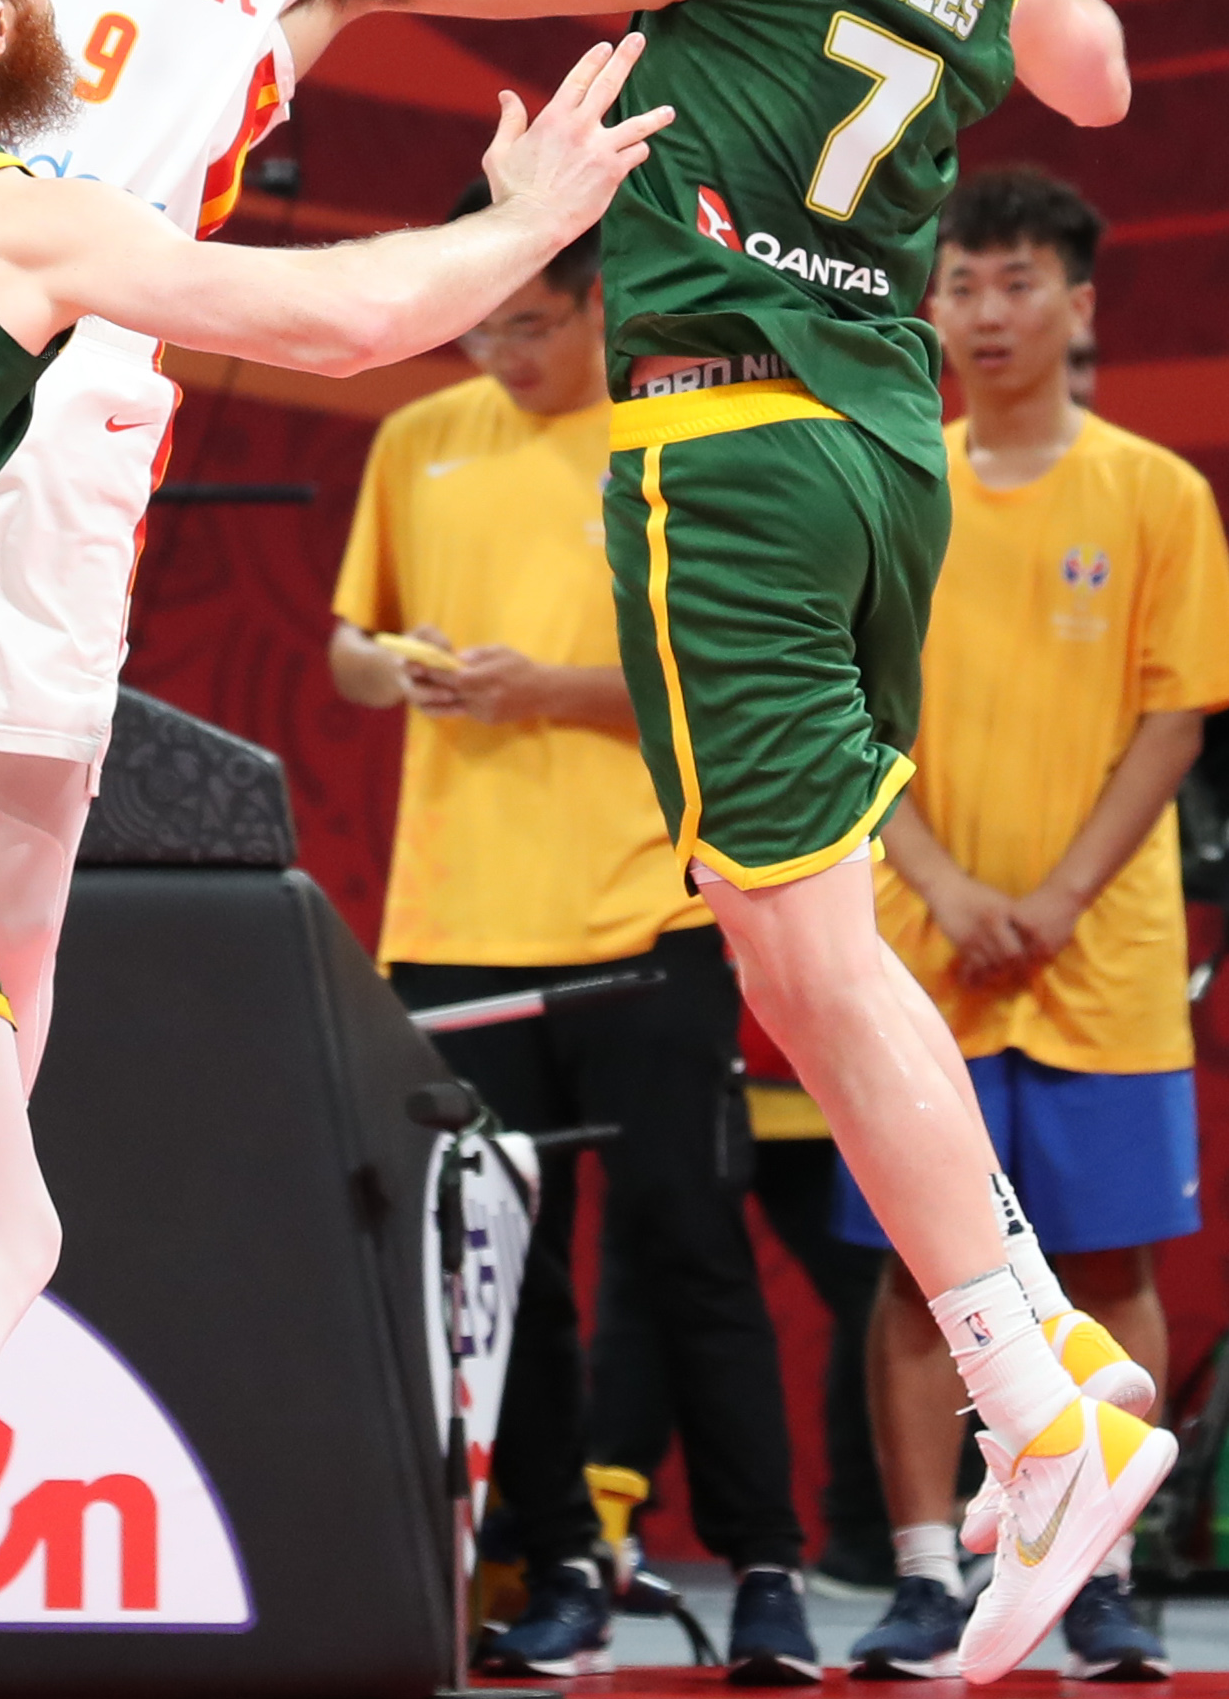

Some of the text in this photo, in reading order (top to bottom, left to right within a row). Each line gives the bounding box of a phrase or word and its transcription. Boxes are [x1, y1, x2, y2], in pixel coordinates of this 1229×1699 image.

[72, 11, 140, 104] 9
[805, 10, 945, 222] 7
[744, 232, 891, 297] QANTAS
